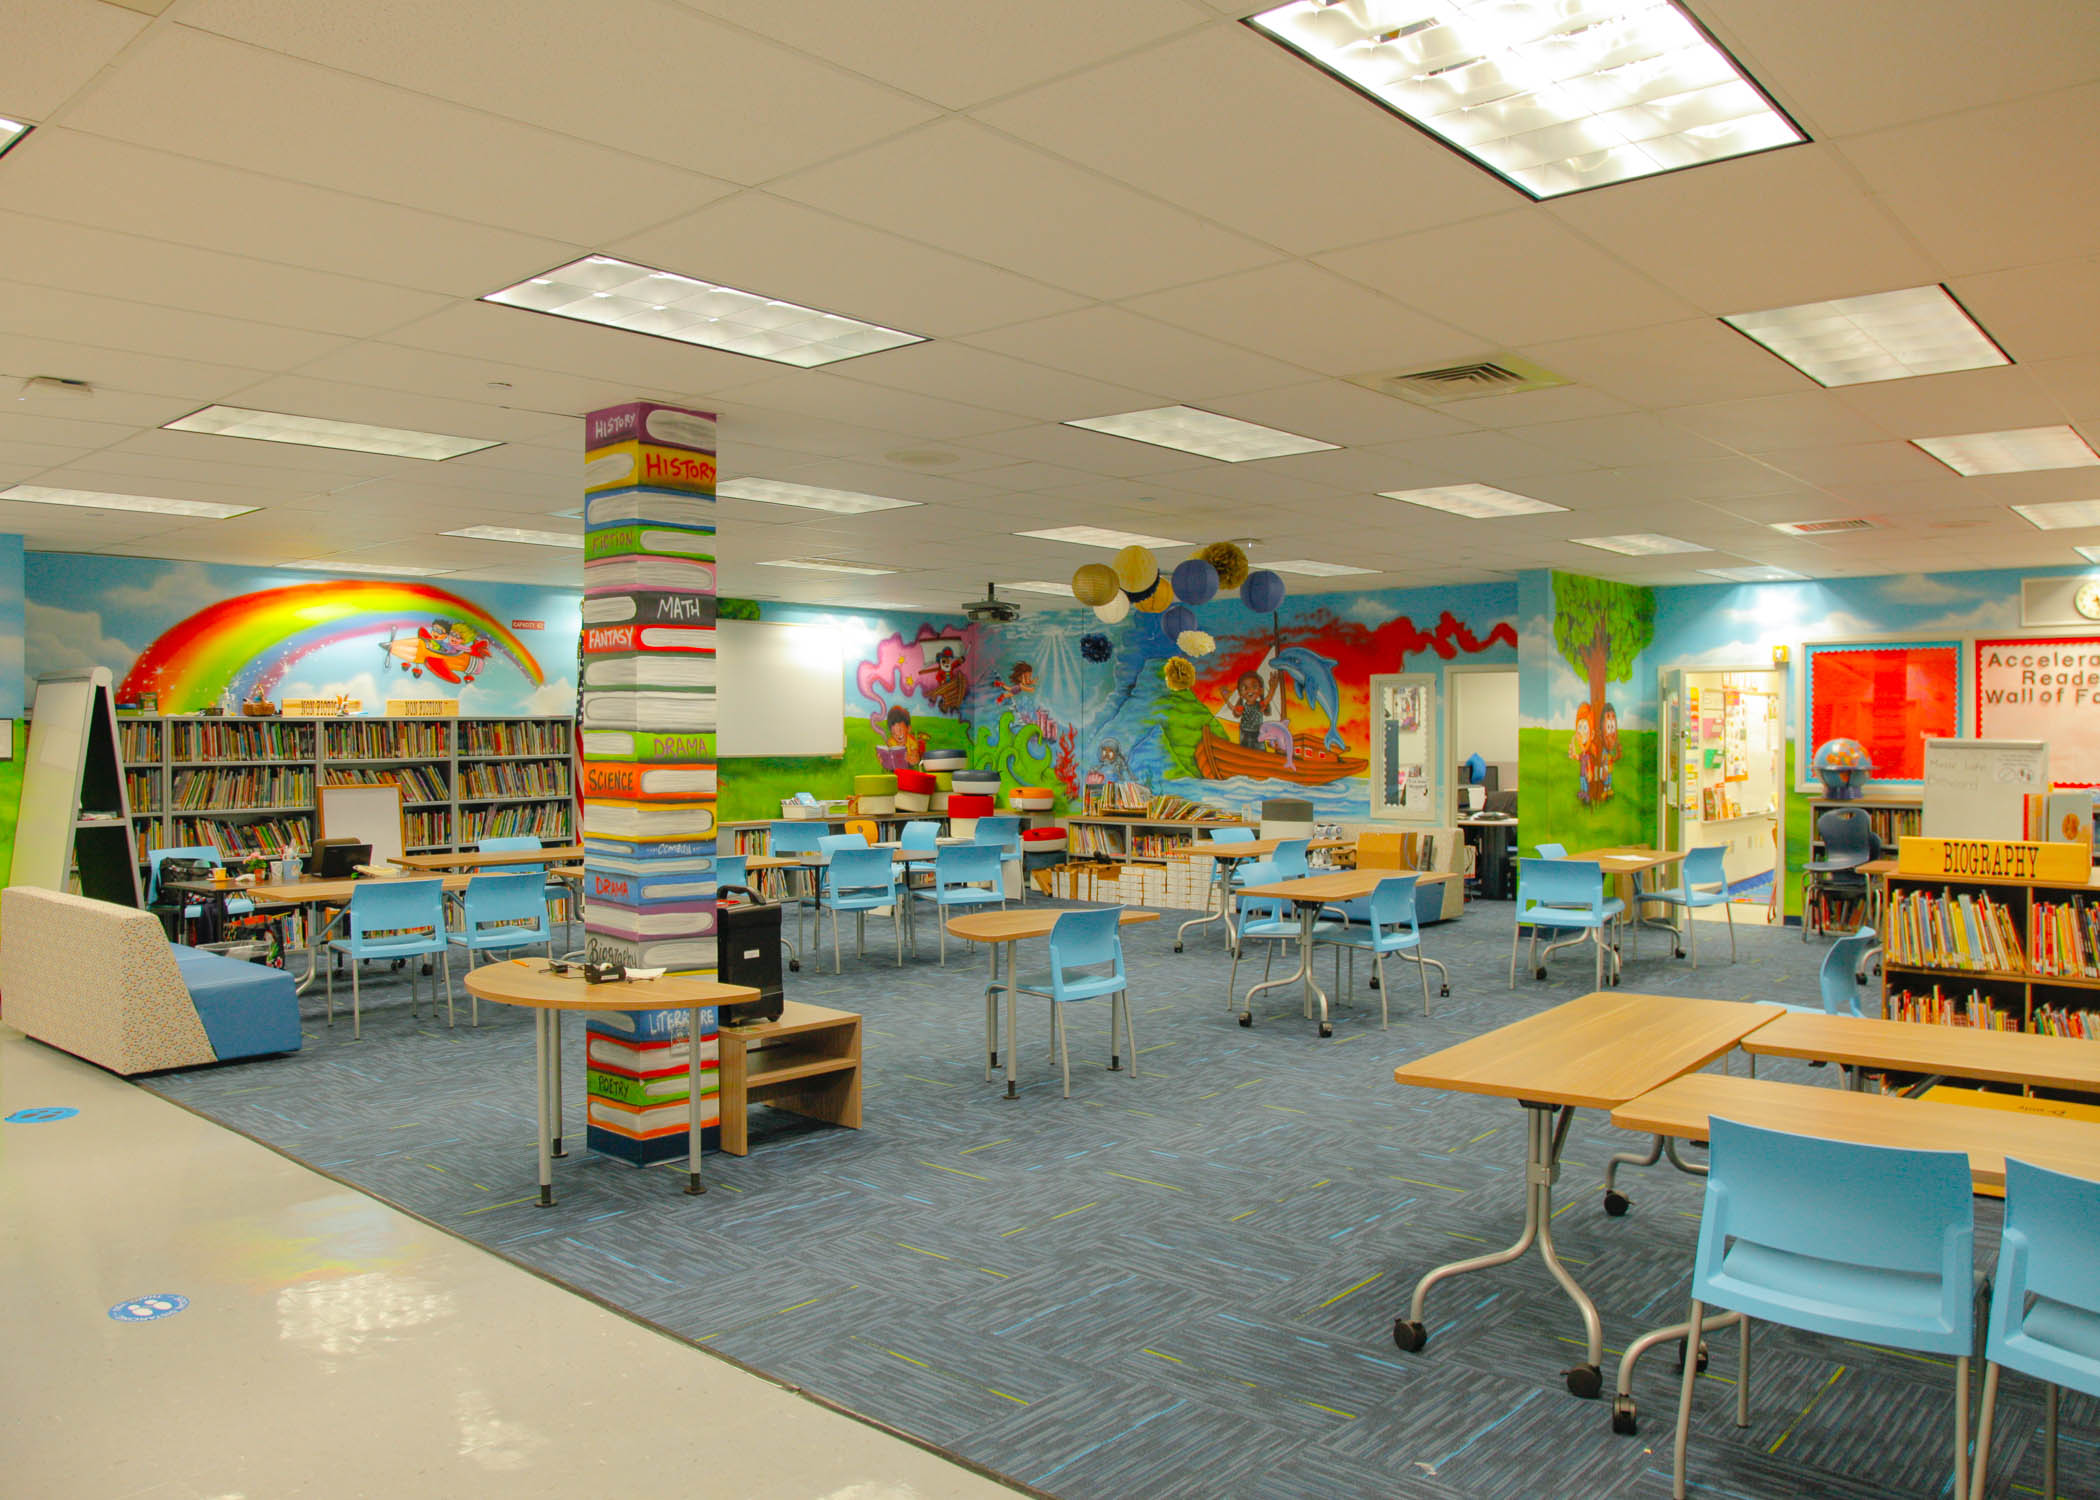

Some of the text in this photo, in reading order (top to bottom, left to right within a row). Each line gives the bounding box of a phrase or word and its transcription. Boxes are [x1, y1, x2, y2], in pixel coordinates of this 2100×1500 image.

[595, 413, 636, 439] HISTORY
[645, 453, 717, 483] HISTORY
[656, 596, 700, 620] MATH
[589, 626, 634, 649] FANTASY
[1988, 652, 2100, 667] Accelera
[1985, 687, 2033, 704] Wall
[2040, 687, 2064, 704] of
[654, 737, 709, 758] DRAMA
[1943, 842, 2040, 878] BIOGRAPHY
[595, 876, 630, 899] DRAMA
[648, 1010, 716, 1034] LITERARE
[598, 1076, 630, 1097] POETRY
